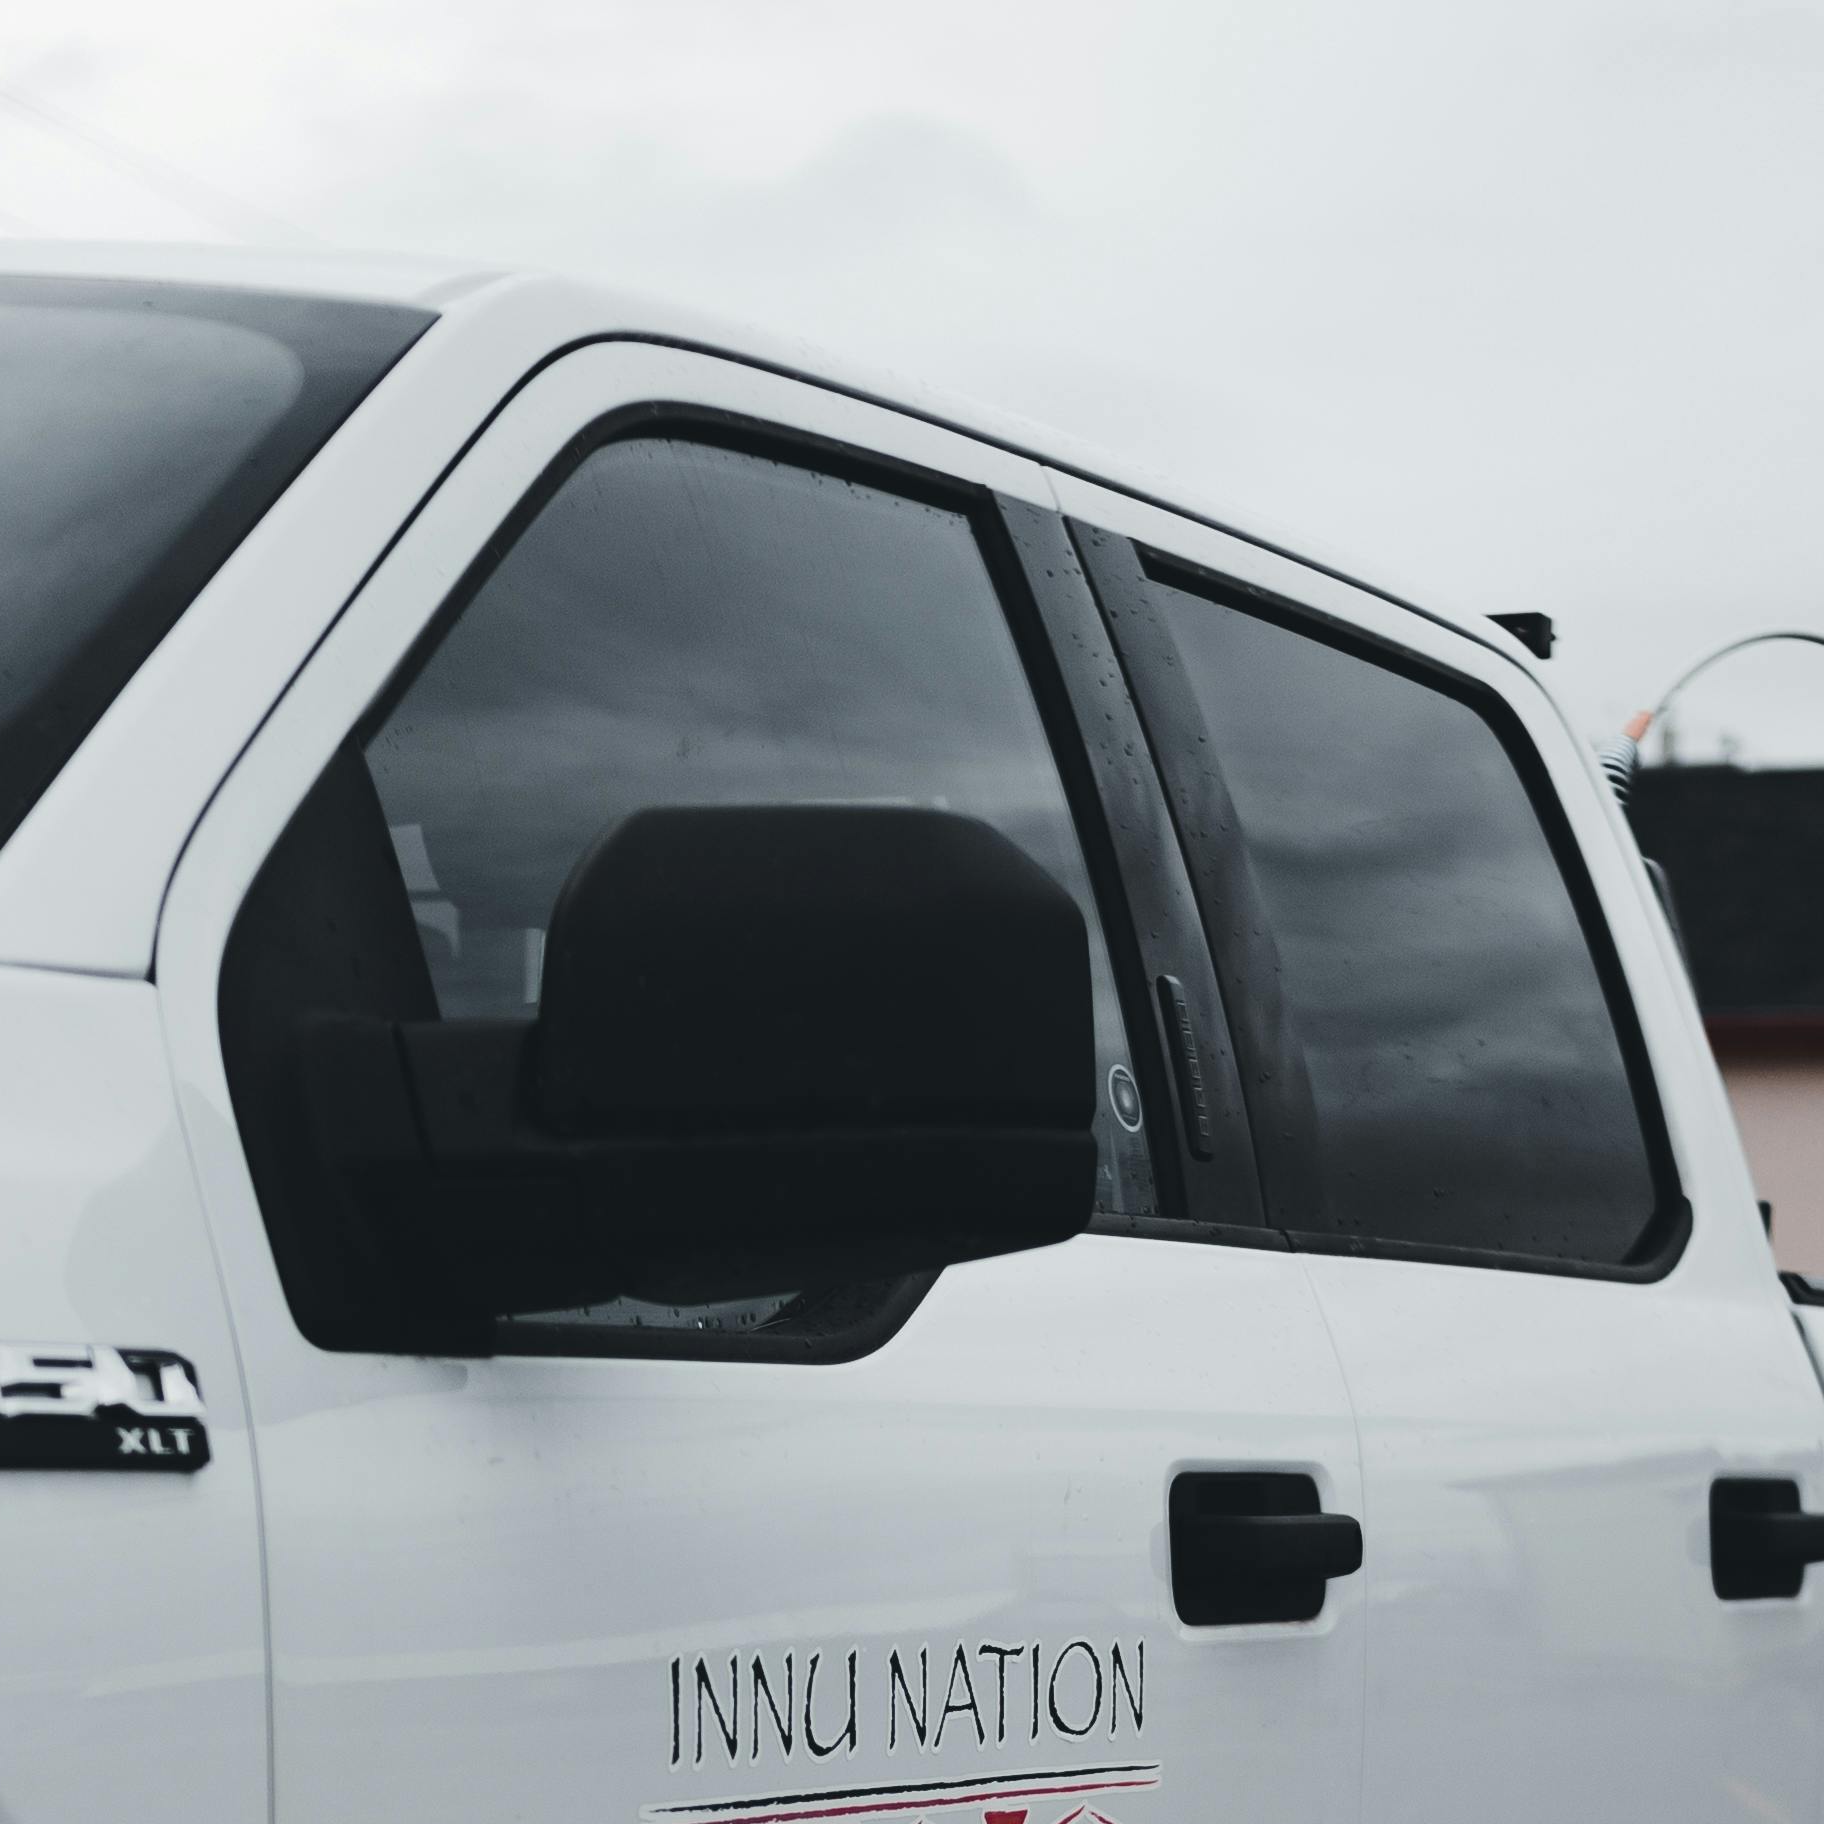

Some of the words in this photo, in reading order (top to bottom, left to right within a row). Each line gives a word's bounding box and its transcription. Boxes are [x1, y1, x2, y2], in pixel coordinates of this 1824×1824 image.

[115, 1426, 196, 1456] XLT
[670, 1650, 857, 1765] INNU
[886, 1641, 1144, 1751] NATION
